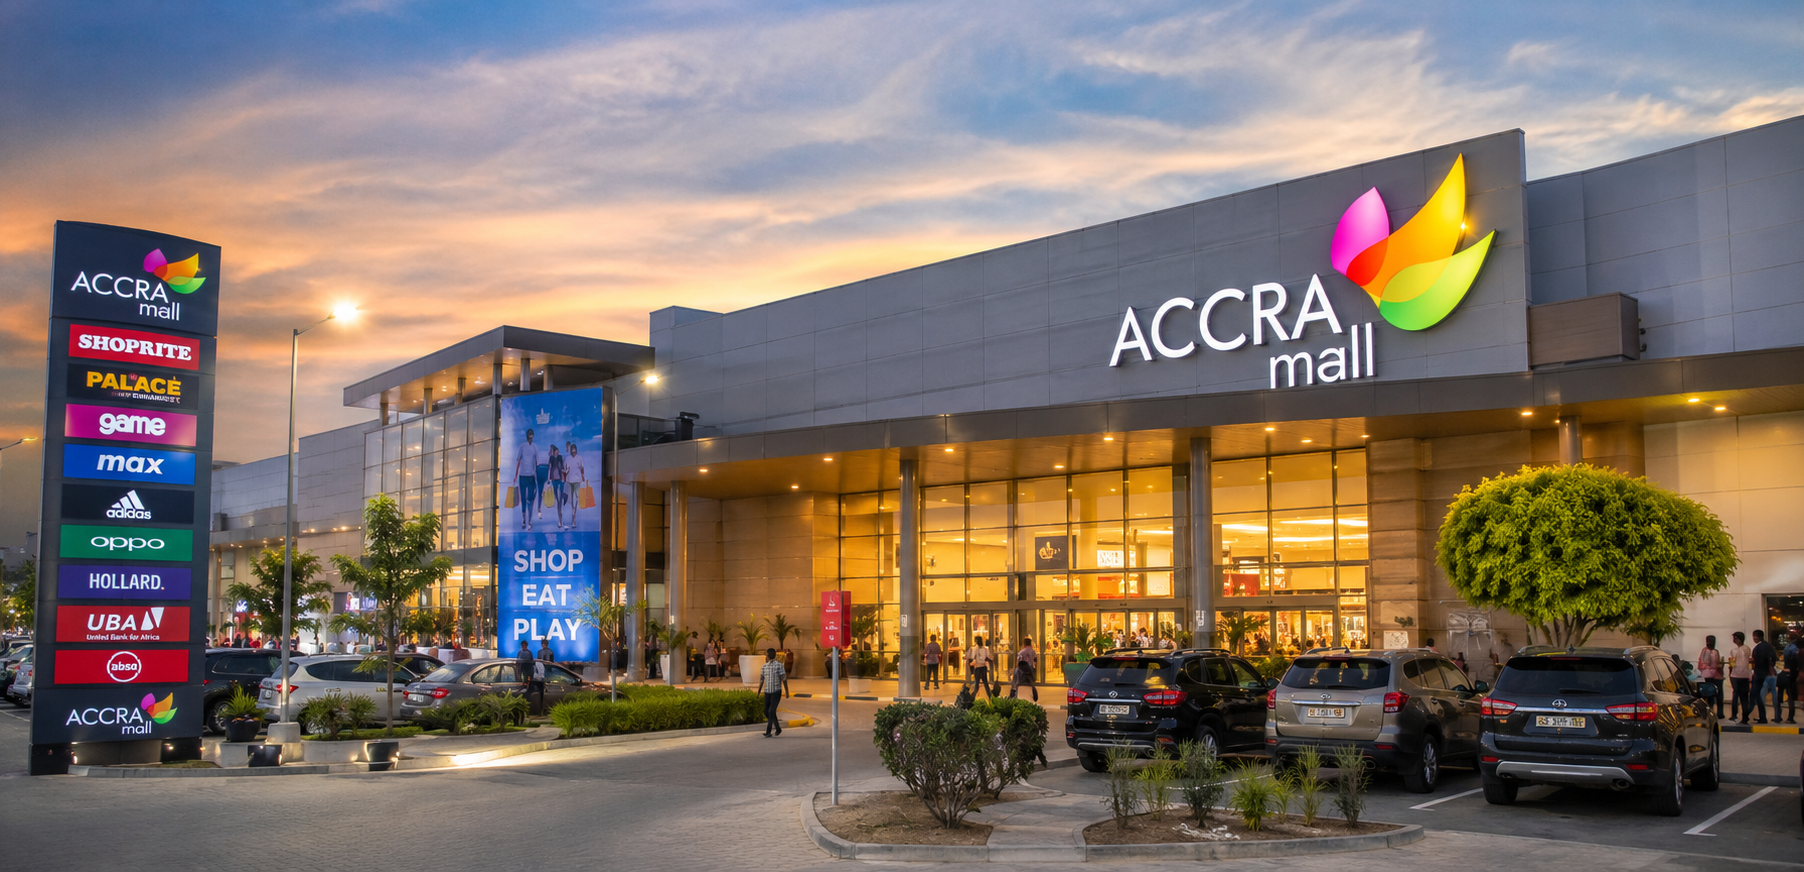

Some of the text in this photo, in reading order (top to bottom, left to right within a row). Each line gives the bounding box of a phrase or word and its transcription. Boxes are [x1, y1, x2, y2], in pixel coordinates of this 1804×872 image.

[71, 270, 169, 303] ACCRA
[139, 302, 180, 321] mall
[1108, 273, 1345, 367] ACCRA
[78, 334, 192, 361] SHOPRITE
[1269, 321, 1376, 389] mall
[99, 413, 166, 436] game
[96, 454, 165, 475] max
[106, 508, 152, 520] adidas
[90, 536, 165, 551] oppo
[513, 549, 584, 572] SHOP
[89, 573, 165, 590] HOLLARD.
[522, 583, 572, 606] EAT
[87, 614, 137, 631] UBA
[513, 618, 583, 641] PLAY
[111, 661, 138, 671] absa
[65, 707, 144, 726] ACCRA
[121, 720, 152, 735] mall
